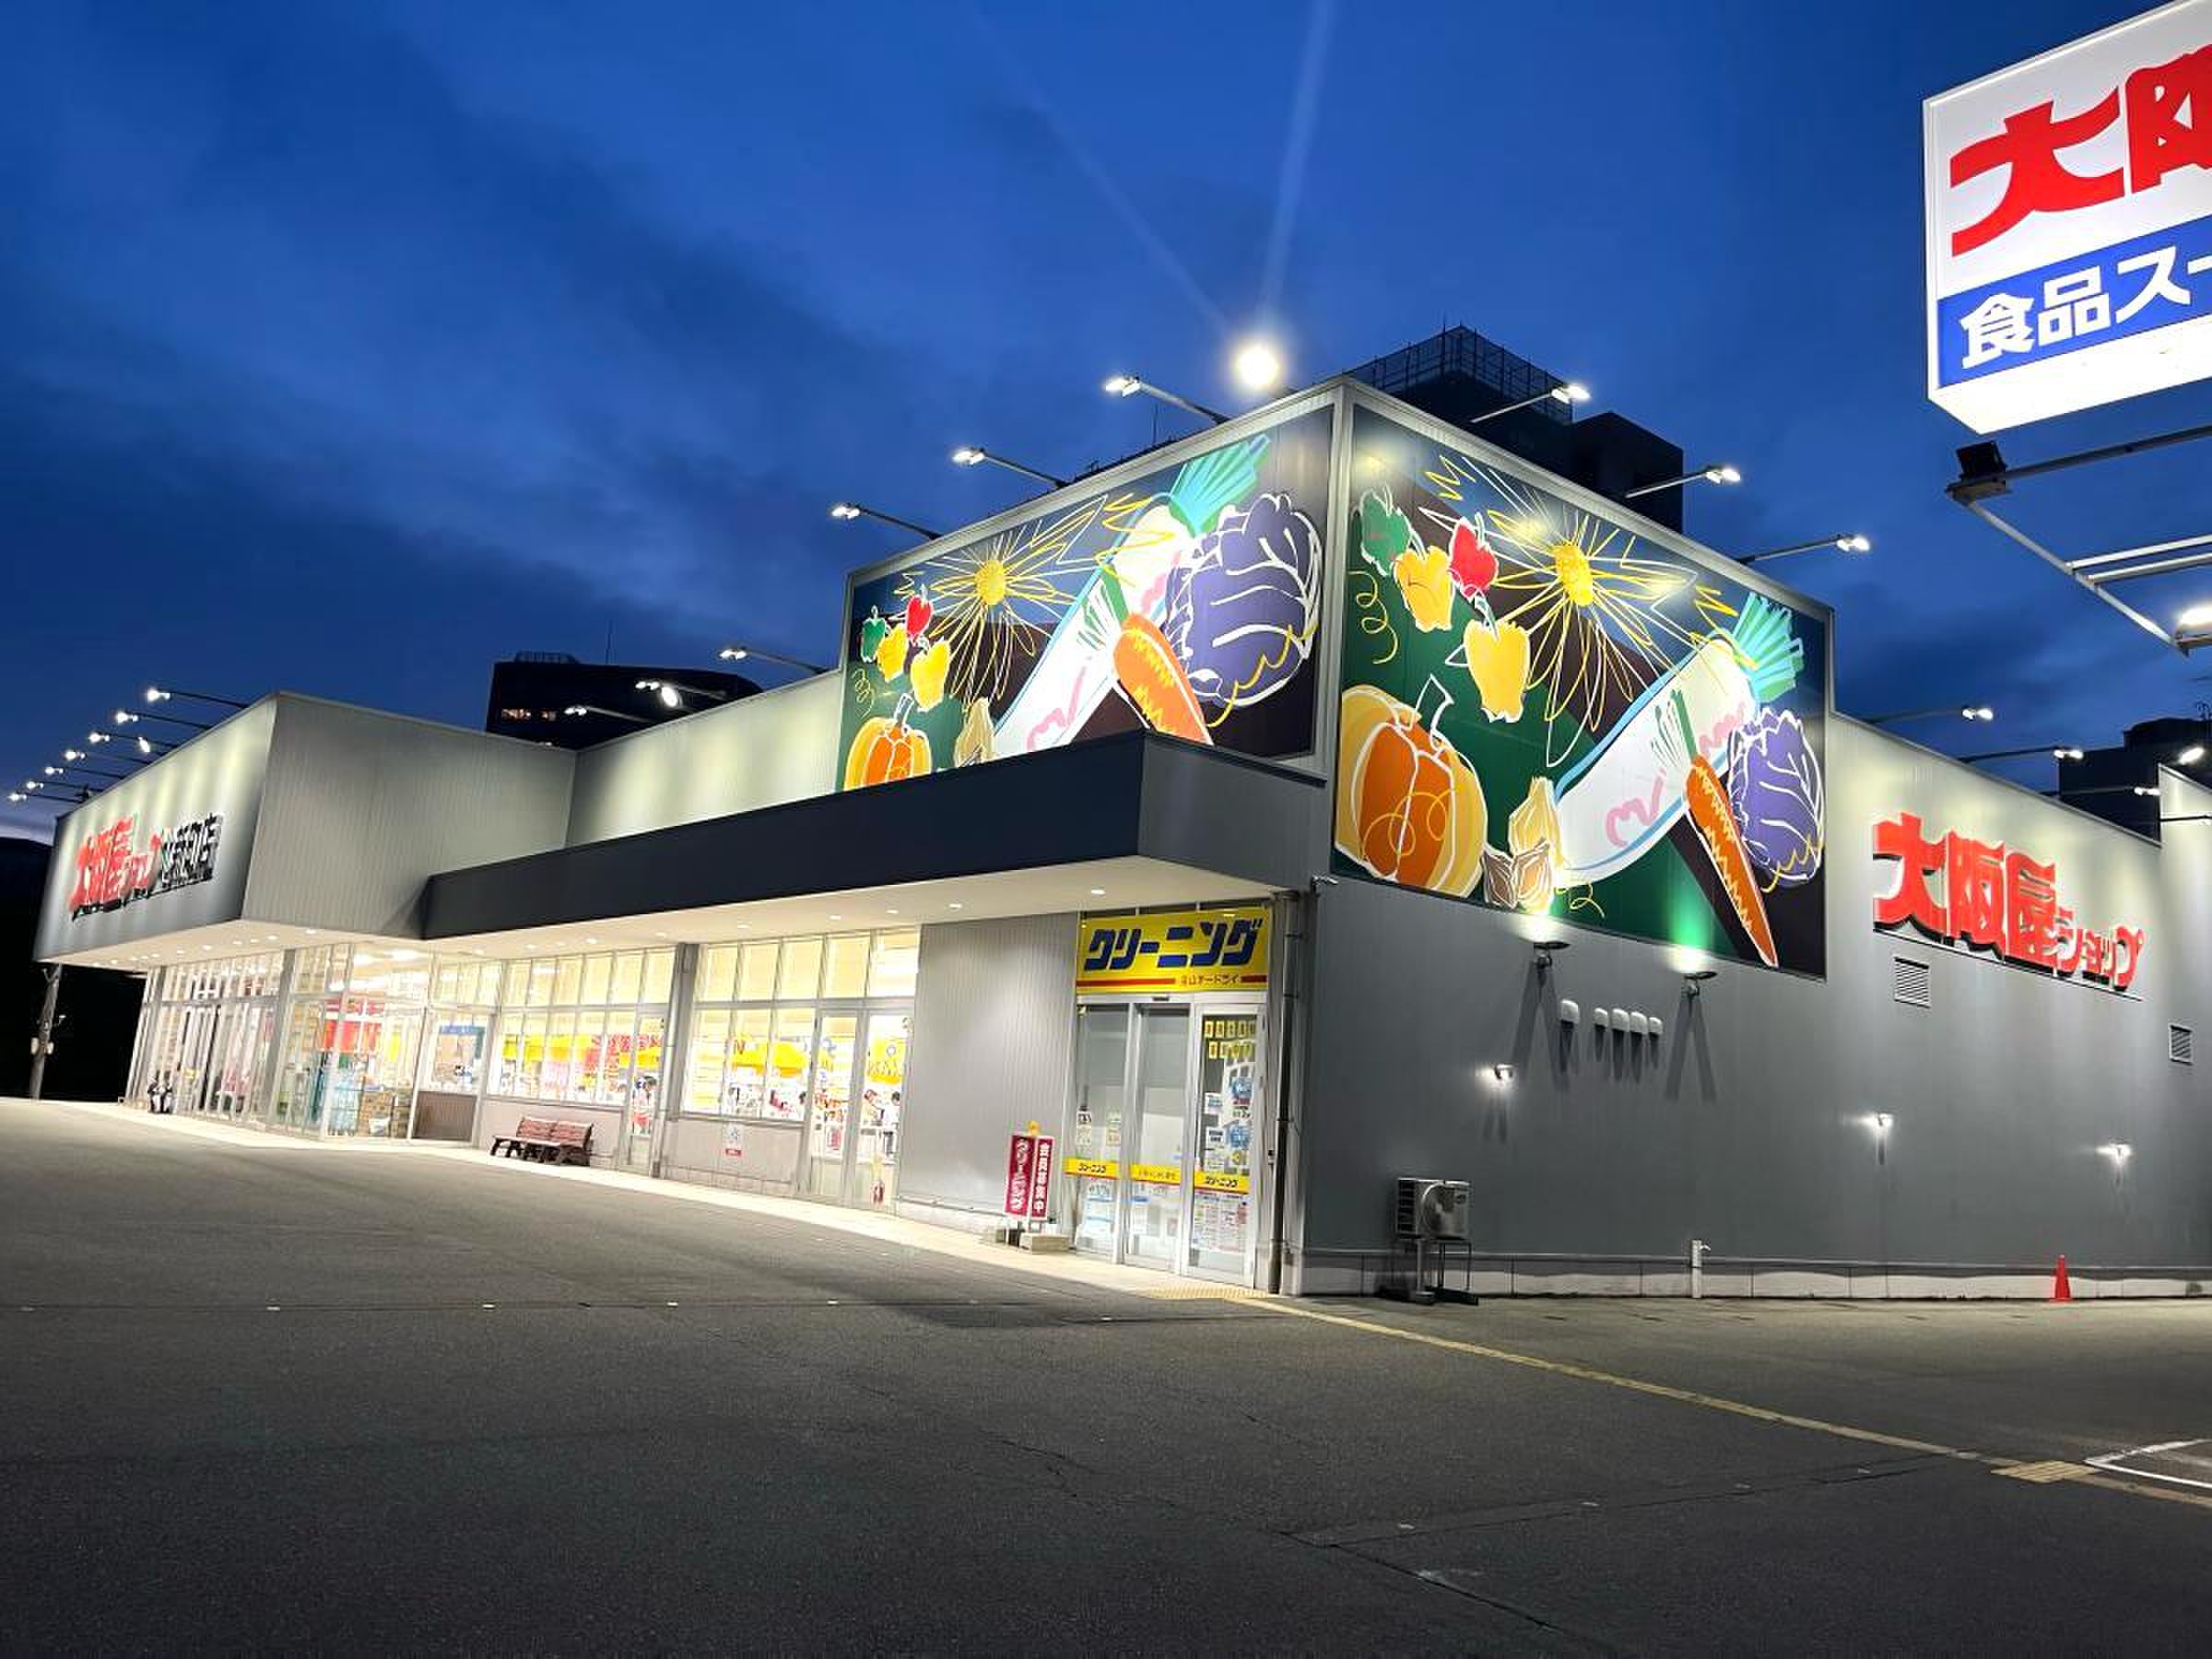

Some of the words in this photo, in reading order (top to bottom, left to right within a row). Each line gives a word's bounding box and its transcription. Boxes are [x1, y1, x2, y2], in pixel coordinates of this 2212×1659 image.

[1085, 919, 1263, 971] クリーニング
[1873, 812, 2145, 991] 大阪屋ショップ
